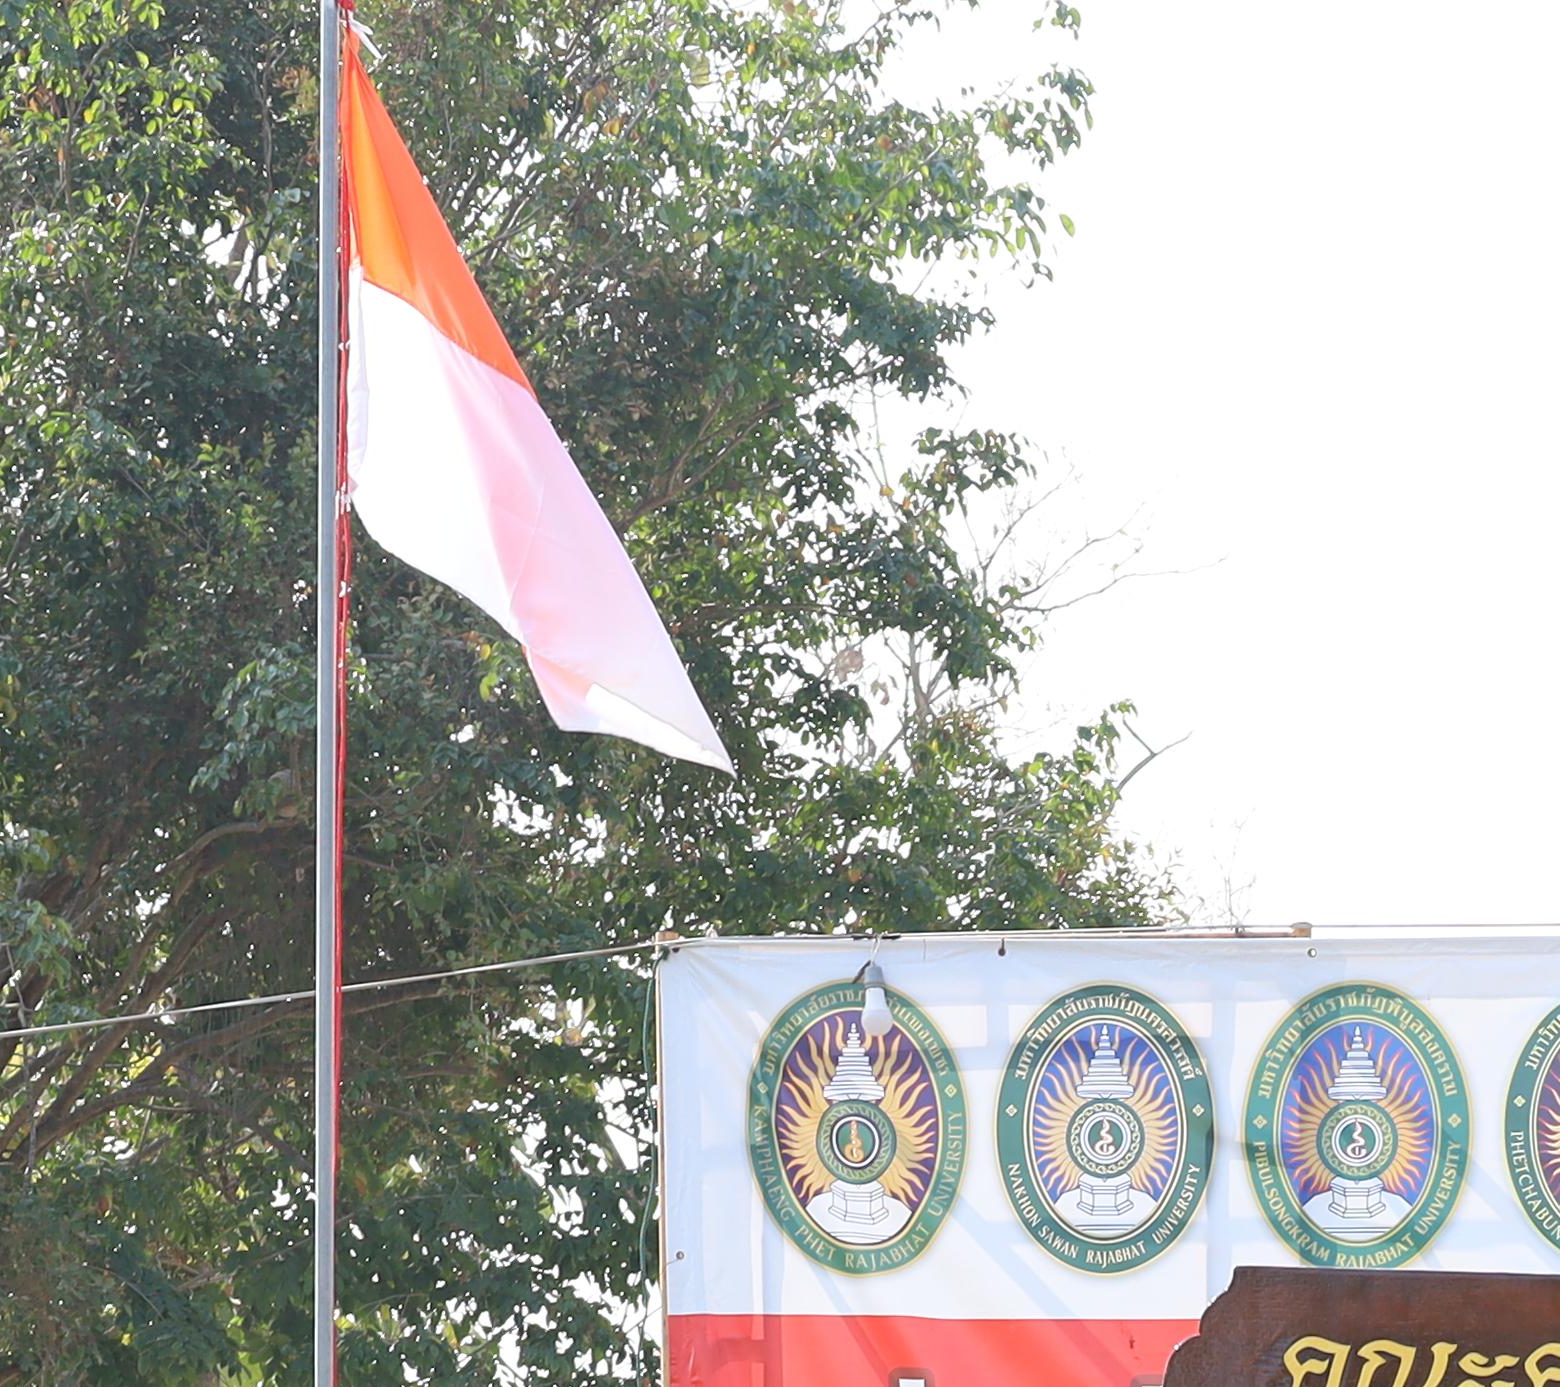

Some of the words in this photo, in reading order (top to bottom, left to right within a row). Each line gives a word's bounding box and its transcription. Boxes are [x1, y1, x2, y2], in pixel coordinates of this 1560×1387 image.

[754, 1104, 795, 1222] KAMPHAENG
[795, 1226, 837, 1262] PHET
[845, 1225, 931, 1272] RAJABHAT
[928, 1110, 963, 1218] UNIVERSITY
[1008, 1162, 1040, 1229] NAKHON
[1038, 1224, 1080, 1259] SAWAN
[1086, 1241, 1146, 1270] RAJABHAT
[1151, 1162, 1201, 1245] UNIVERSITY
[1253, 1140, 1331, 1263] PIBULSONGKRAM
[1414, 1140, 1462, 1236] UNIVERSITY
